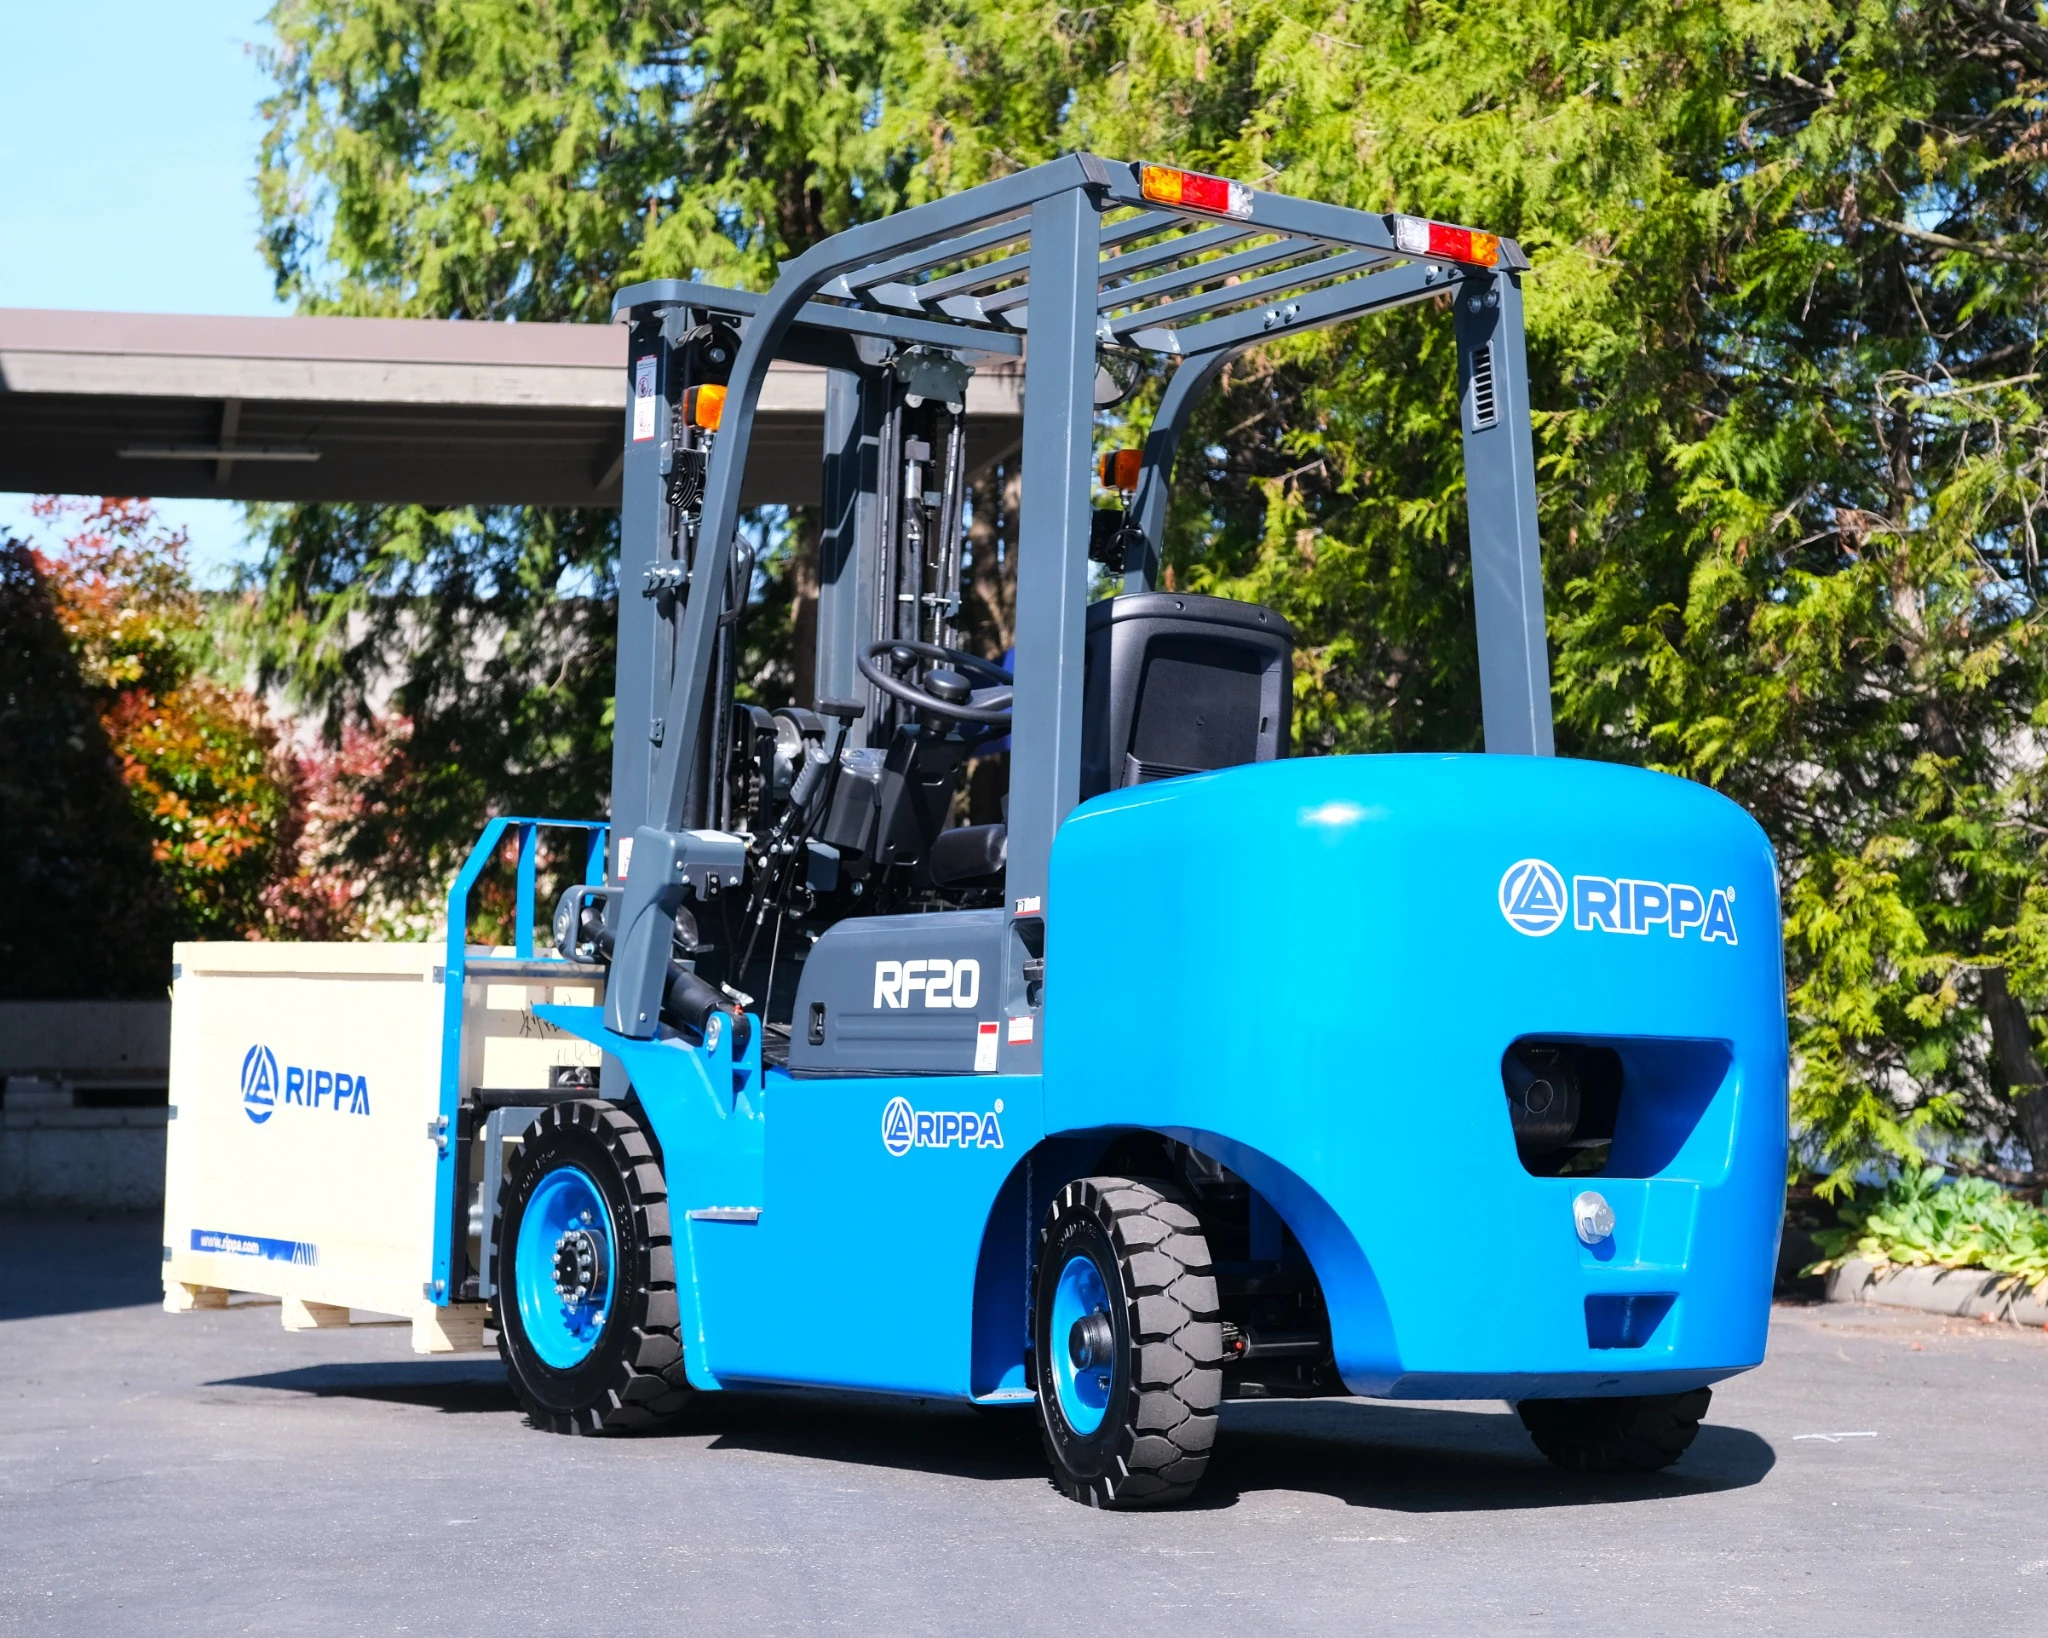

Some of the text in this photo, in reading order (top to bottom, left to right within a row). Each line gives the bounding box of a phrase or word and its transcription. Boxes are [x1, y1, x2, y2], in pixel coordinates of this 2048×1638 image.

[1573, 875, 1738, 945] RIPPA
[874, 959, 980, 1009] RF20
[285, 1066, 370, 1116] RIPPA
[915, 1112, 1004, 1149] RIPPA
